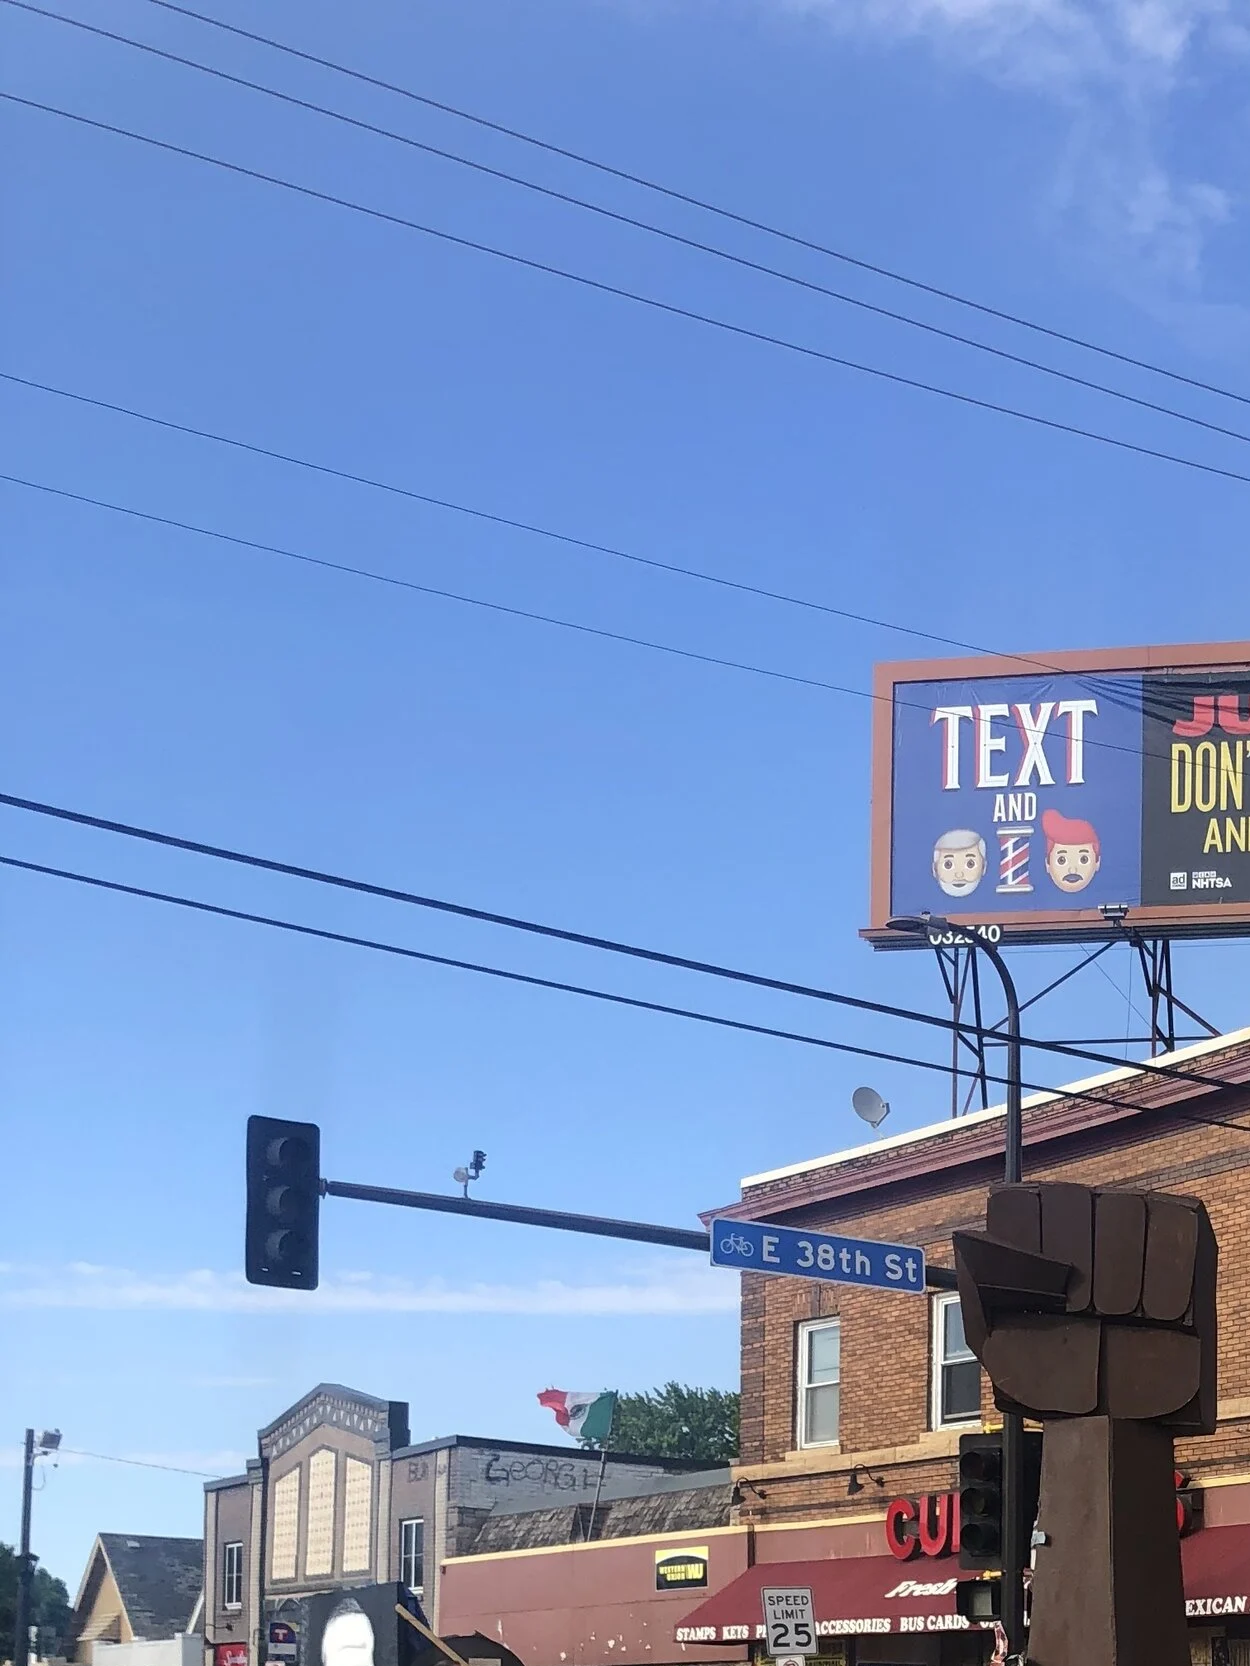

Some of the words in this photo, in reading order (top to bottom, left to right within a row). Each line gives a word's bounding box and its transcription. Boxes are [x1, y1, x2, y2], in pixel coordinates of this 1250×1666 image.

[933, 700, 1098, 790] TEXT
[993, 793, 1037, 822] AND
[1192, 877, 1232, 889] NHTSA
[762, 1235, 780, 1264] E
[796, 1240, 872, 1277] 38th
[886, 1253, 918, 1285] St
[659, 1565, 685, 1574] WESTERN
[666, 1573, 685, 1582] UNION
[884, 1577, 958, 1599] Fresh
[768, 1596, 809, 1606] SPEED
[1185, 1596, 1248, 1616] EXICAN
[773, 1609, 806, 1620] LIMIT
[676, 1626, 716, 1641] STAMPS
[722, 1625, 749, 1640] KEYS
[900, 1616, 925, 1632] BUS
[926, 1614, 969, 1630] CARDS
[771, 1623, 812, 1648] 25
